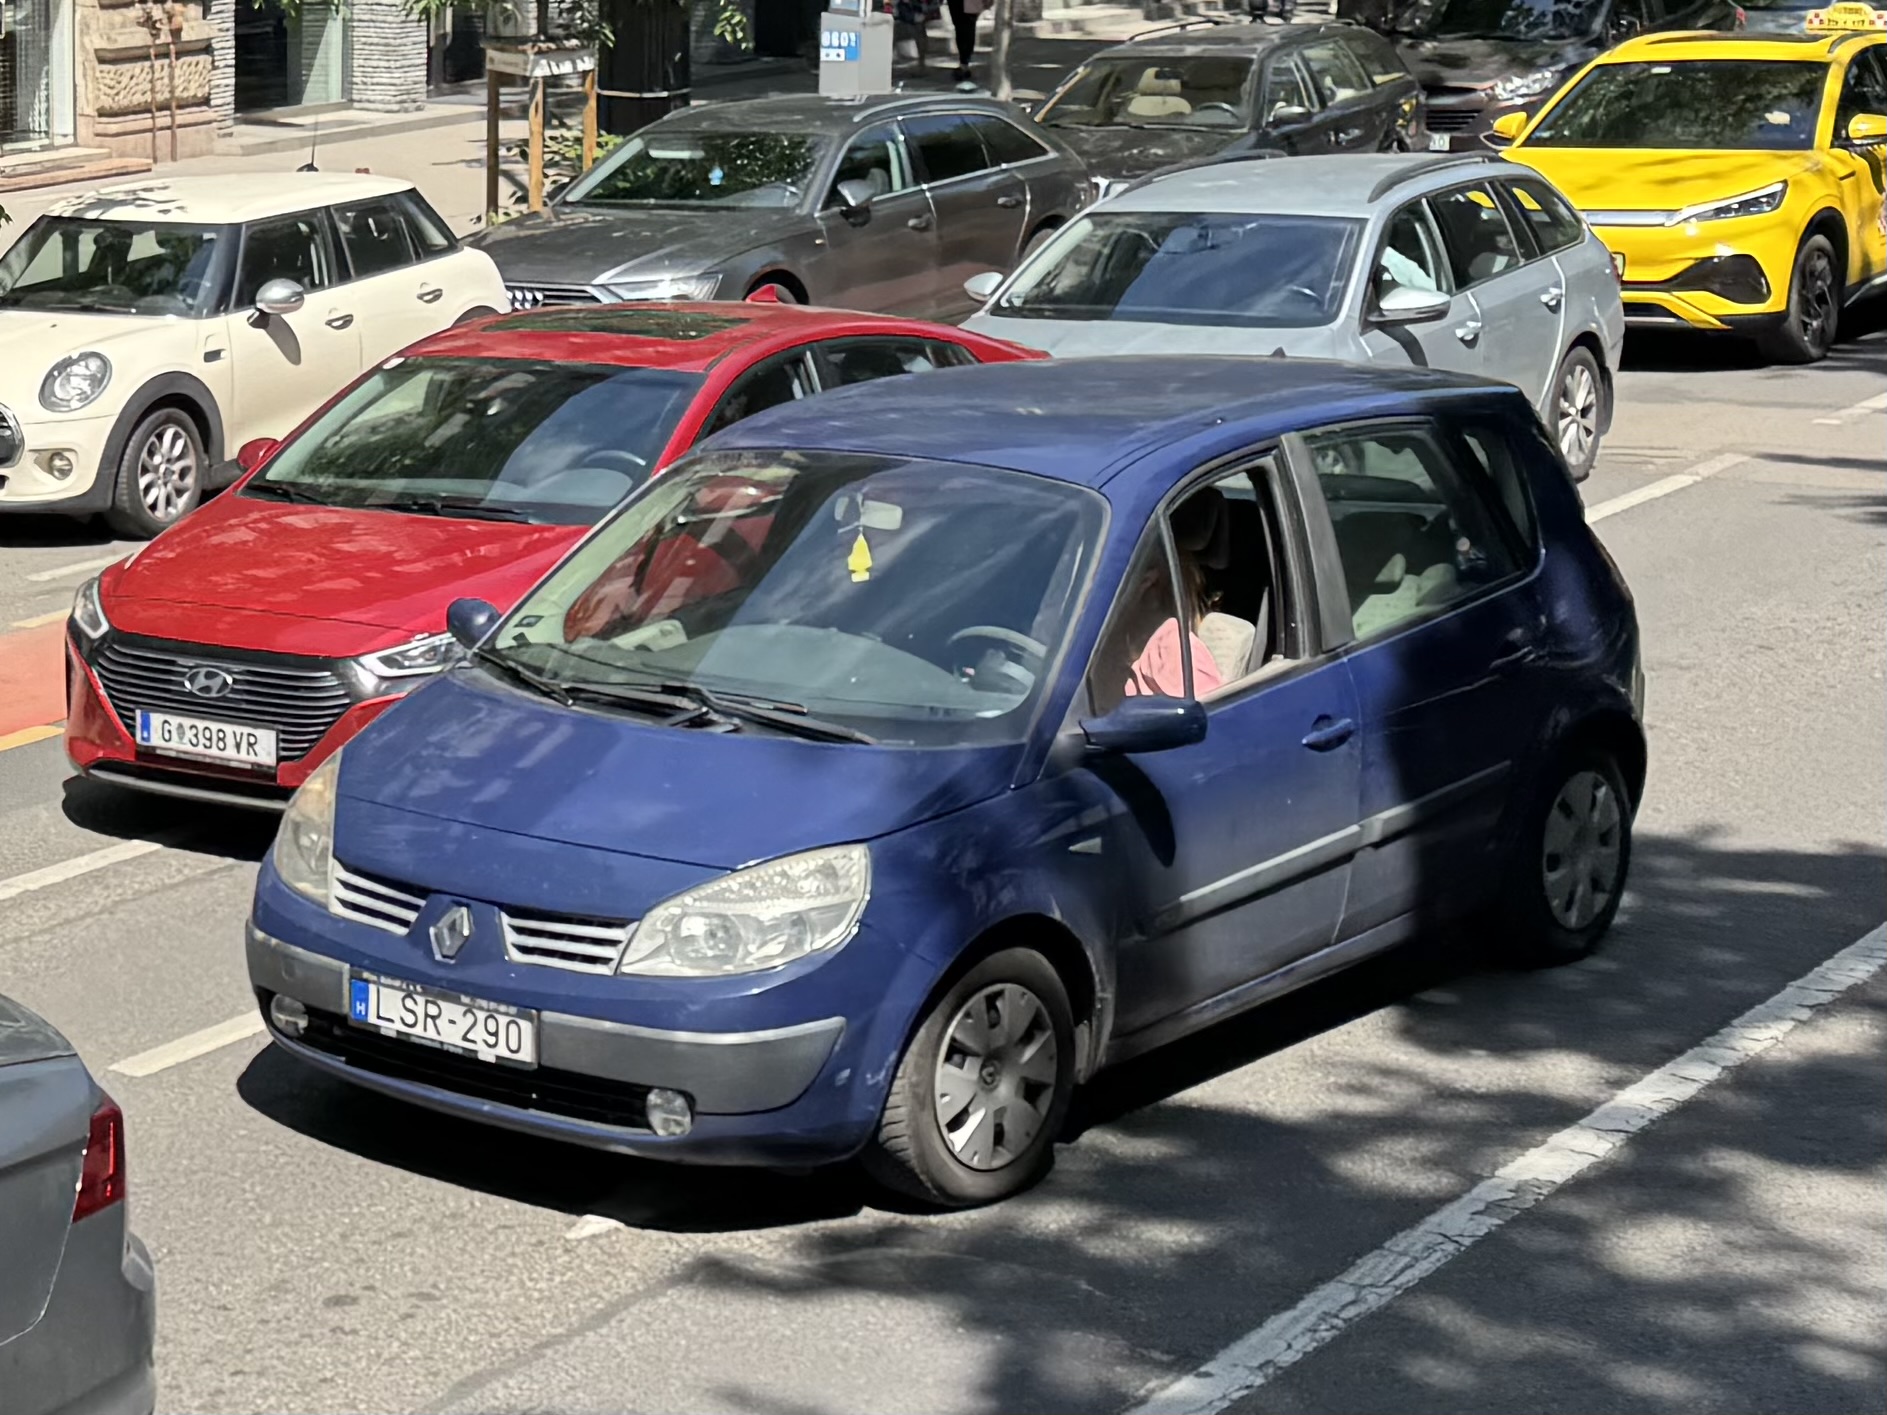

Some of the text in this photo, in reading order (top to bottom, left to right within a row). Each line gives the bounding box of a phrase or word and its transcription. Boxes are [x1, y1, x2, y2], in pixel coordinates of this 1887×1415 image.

[161, 719, 258, 757] G 398 VR
[355, 1001, 366, 1015] H
[376, 985, 522, 1054] LSR-290
